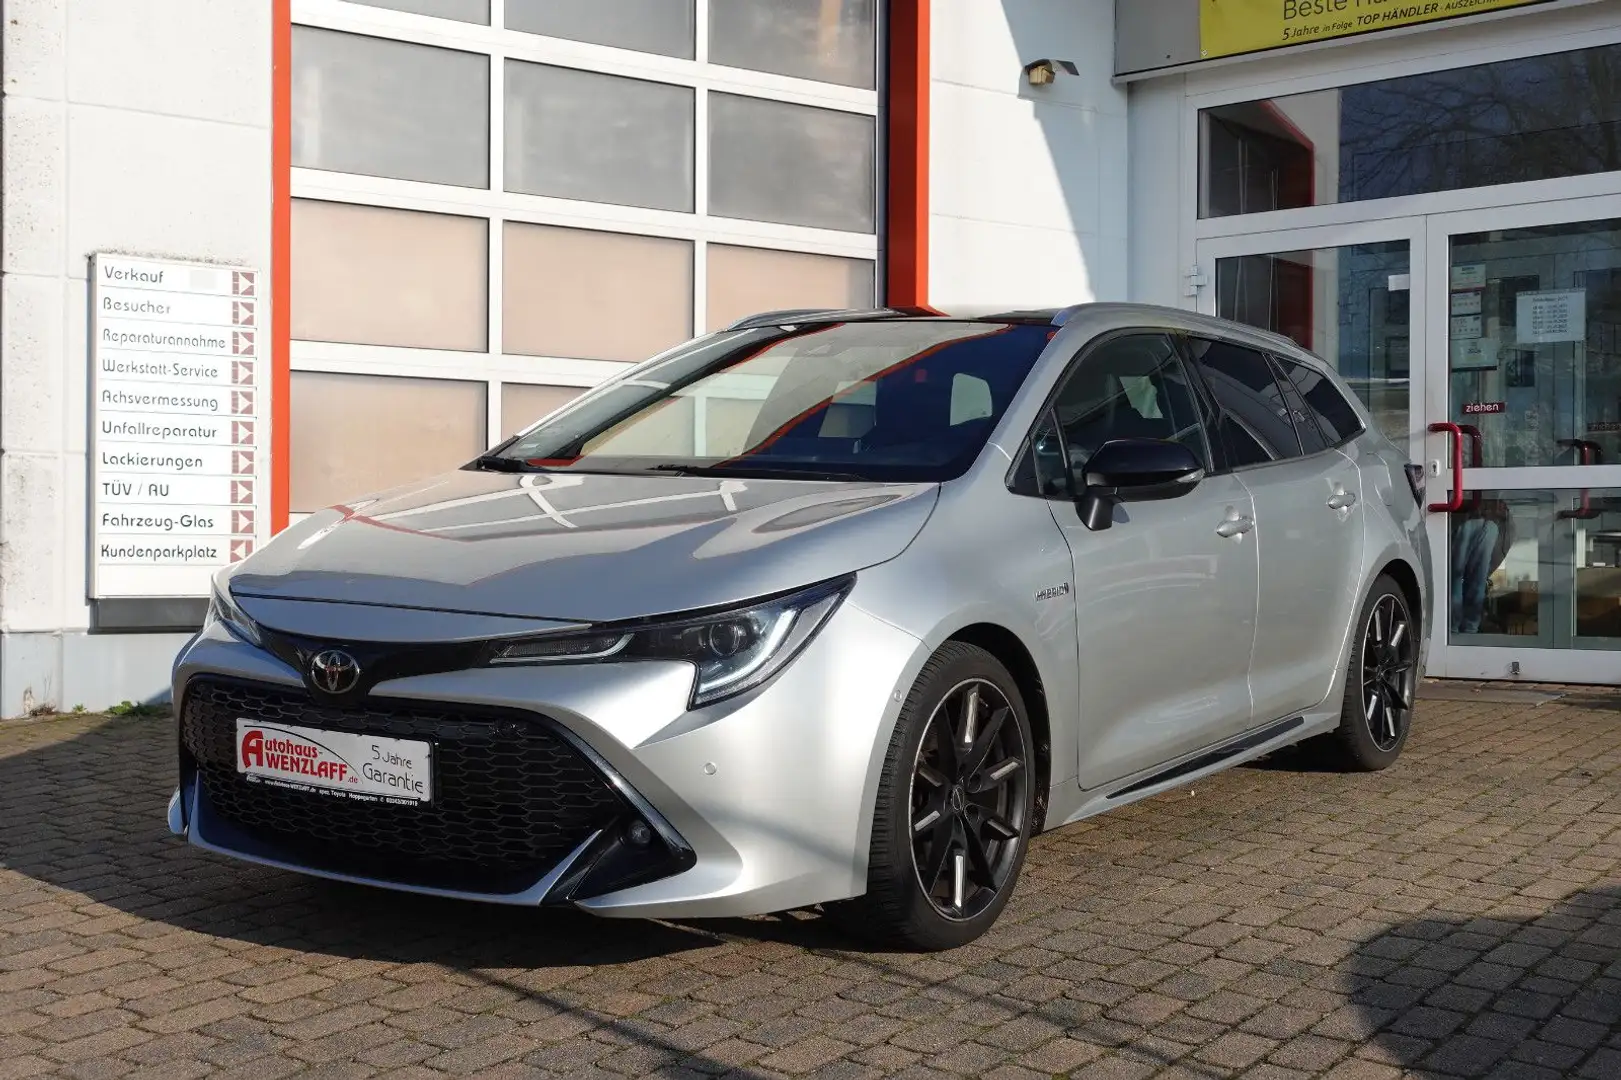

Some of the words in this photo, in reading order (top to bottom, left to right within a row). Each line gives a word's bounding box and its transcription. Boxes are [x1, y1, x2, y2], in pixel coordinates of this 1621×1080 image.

[1282, 28, 1290, 40] 5
[1291, 25, 1320, 38] Jahre
[1322, 24, 1331, 32] in
[1332, 21, 1353, 30] Folge
[1357, 13, 1380, 26] TOP
[1382, 3, 1439, 21] HÄNDLER
[104, 265, 164, 284] Verkauf
[103, 296, 171, 314] Besucher
[103, 328, 226, 349] Reparaturannahme
[102, 359, 218, 378] Werkstatt-Service
[102, 389, 219, 411] Achsvermessung
[1465, 402, 1499, 413] ziehen
[102, 420, 218, 440] Unfallreparatur
[102, 451, 203, 470] Lackierungen
[102, 479, 132, 496] TÜV
[148, 483, 170, 497] AU
[102, 512, 214, 531] Fahrzeug-Glas
[100, 544, 218, 562] Kundenparkplatz
[371, 745, 381, 760] 5
[382, 753, 412, 769] Jahre
[265, 752, 348, 782] WENZLAFF
[362, 762, 424, 794] Garantie
